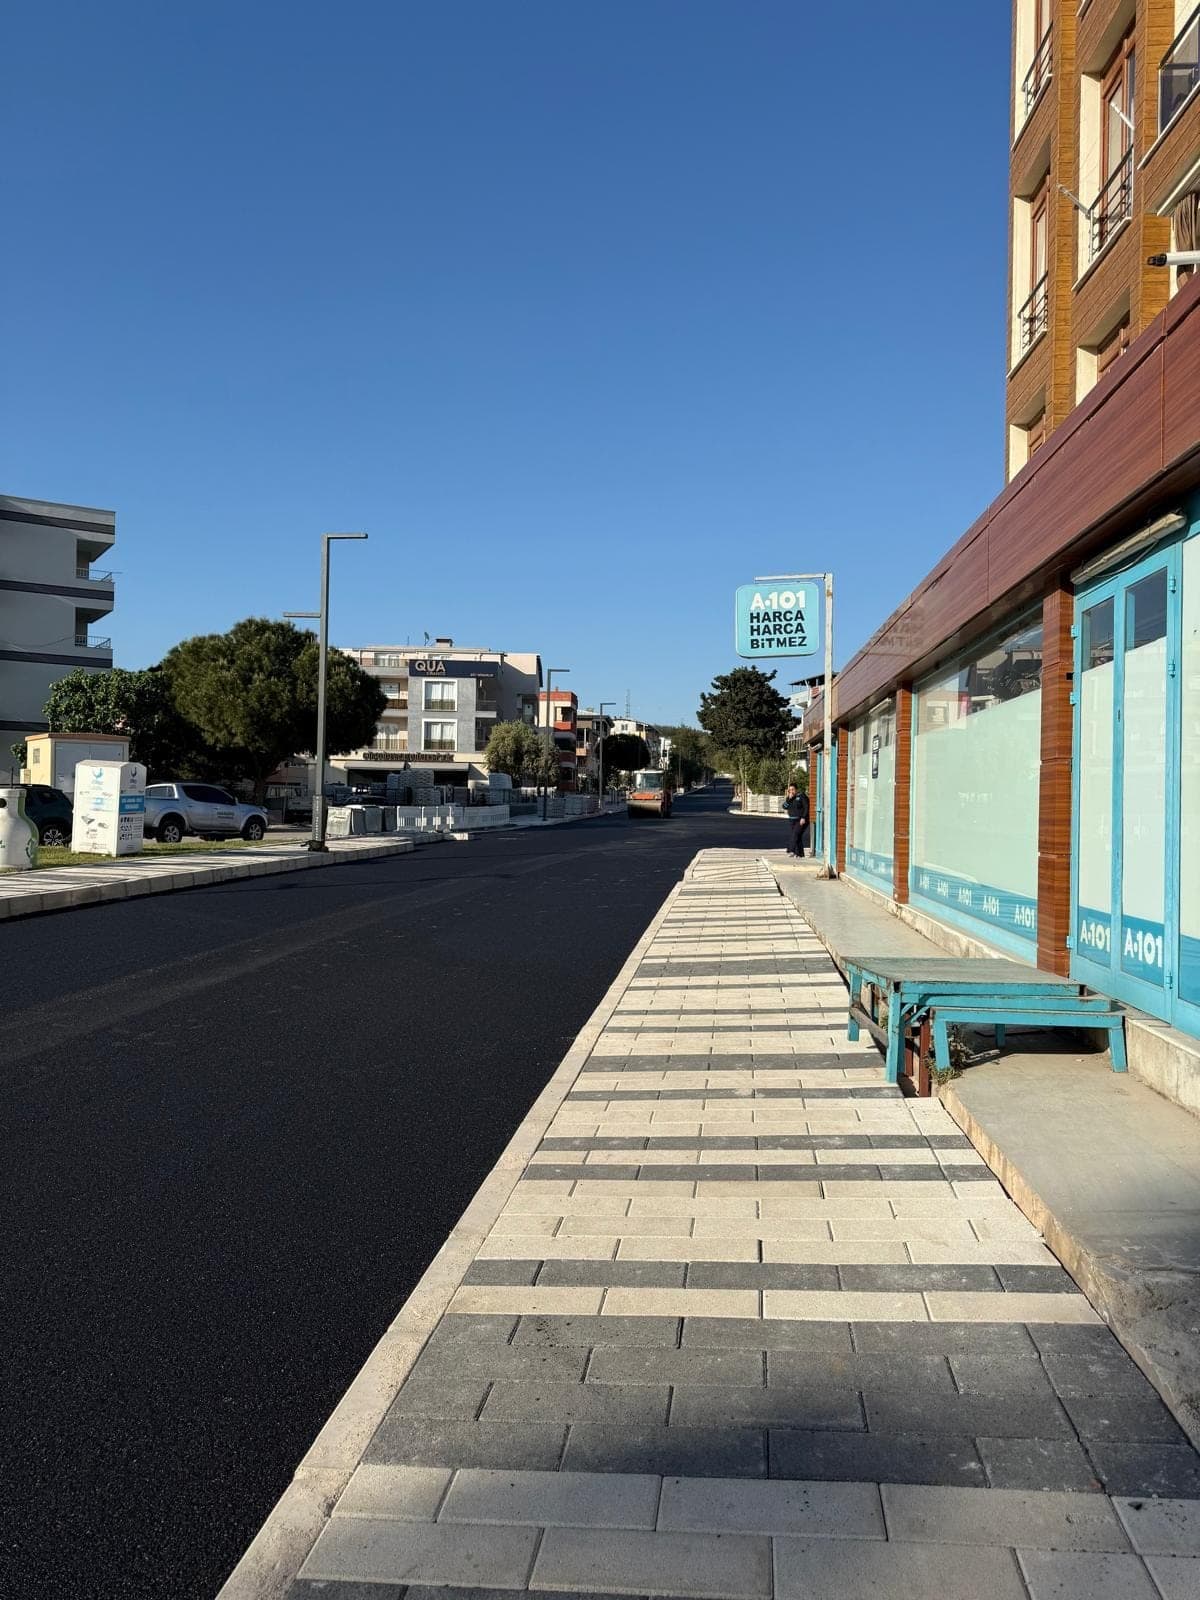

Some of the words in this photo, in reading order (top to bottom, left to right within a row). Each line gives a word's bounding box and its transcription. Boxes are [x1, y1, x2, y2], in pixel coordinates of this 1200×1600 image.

[749, 610, 805, 623] HARCA
[750, 622, 805, 636] HARCA
[415, 661, 446, 672] QUA
